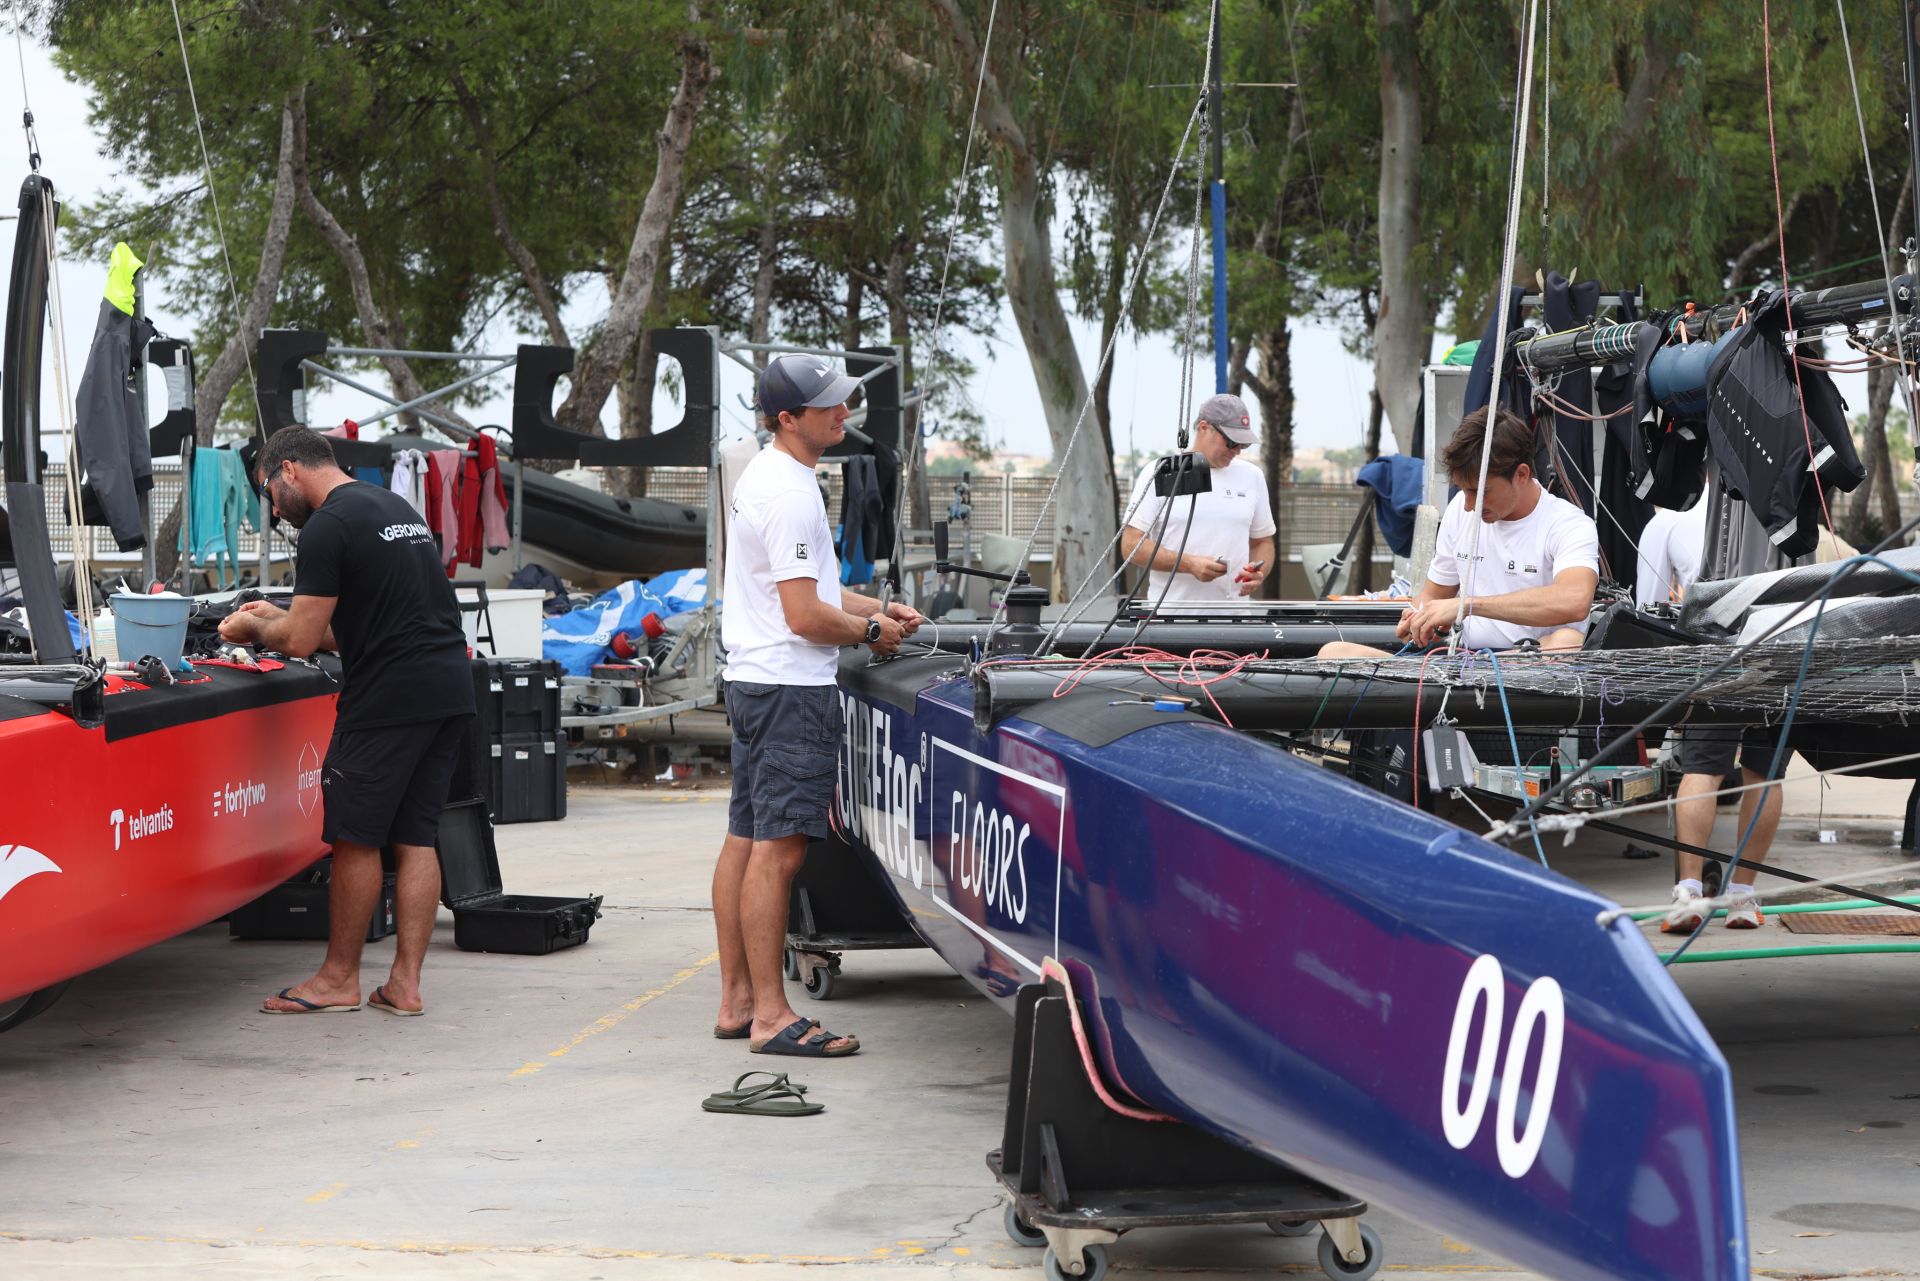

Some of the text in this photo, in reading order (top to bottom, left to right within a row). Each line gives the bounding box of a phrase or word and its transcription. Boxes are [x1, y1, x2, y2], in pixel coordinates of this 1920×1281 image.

[1274, 630, 1283, 638] 2
[225, 780, 265, 816] fortytwo
[129, 803, 173, 840] telvantis
[950, 790, 1031, 924] FLOORS
[1441, 954, 1565, 1178] 00
